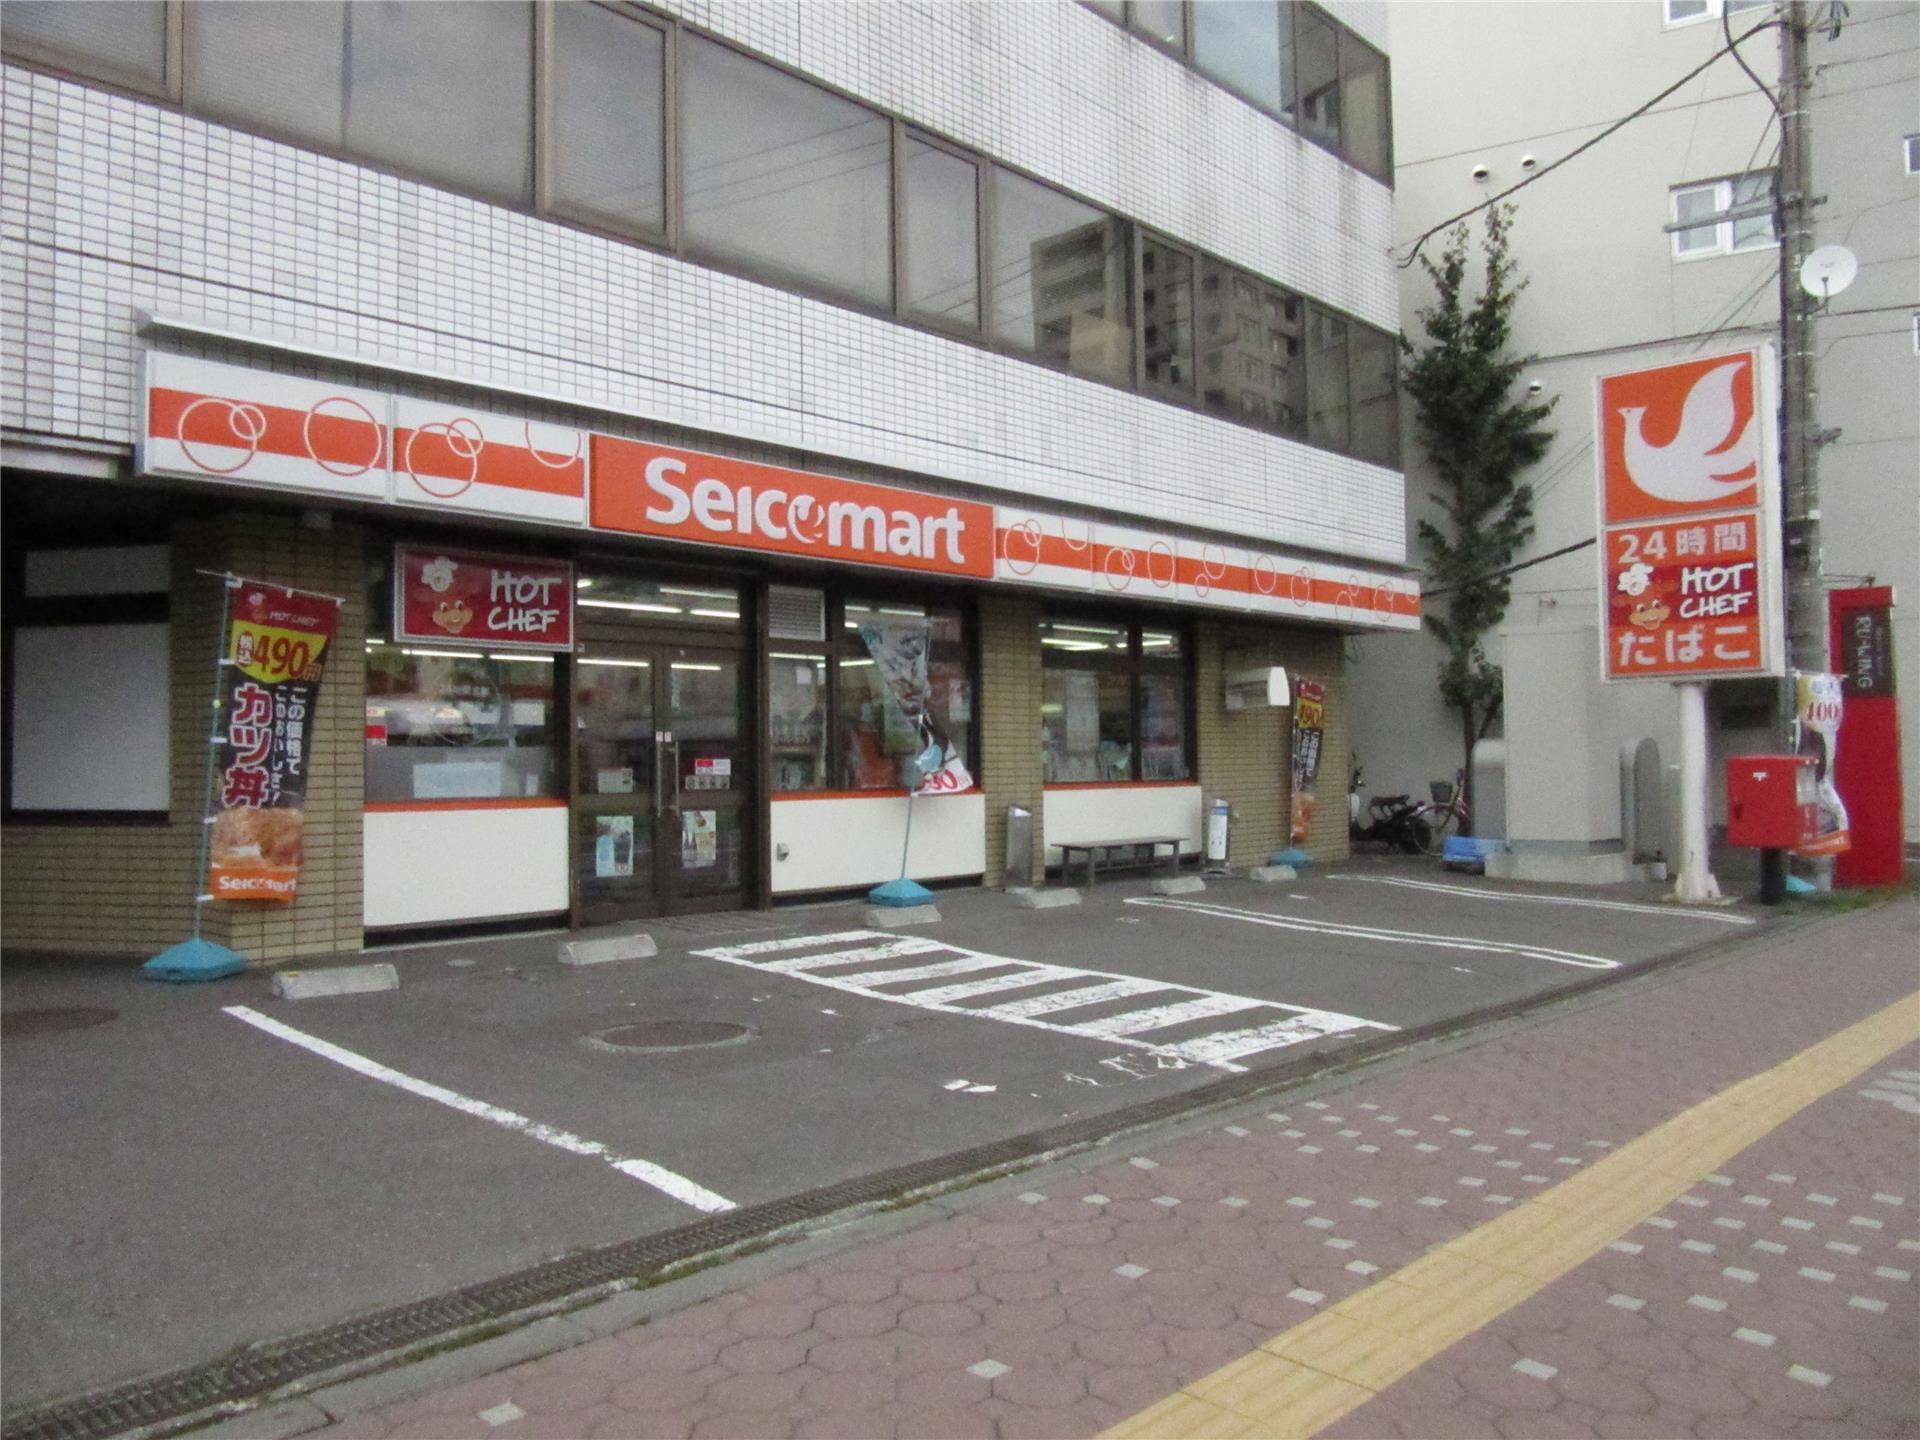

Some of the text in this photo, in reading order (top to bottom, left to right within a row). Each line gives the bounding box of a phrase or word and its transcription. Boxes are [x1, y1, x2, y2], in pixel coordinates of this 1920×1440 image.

[644, 457, 965, 564] Seicomart
[1618, 521, 1747, 564] 24時間
[490, 569, 562, 606] HOT
[1681, 562, 1754, 595] HOT
[487, 607, 560, 632] CHEF
[1679, 592, 1753, 619] CHEF
[1618, 624, 1751, 666] たばこ
[221, 682, 273, 809] カツ丼
